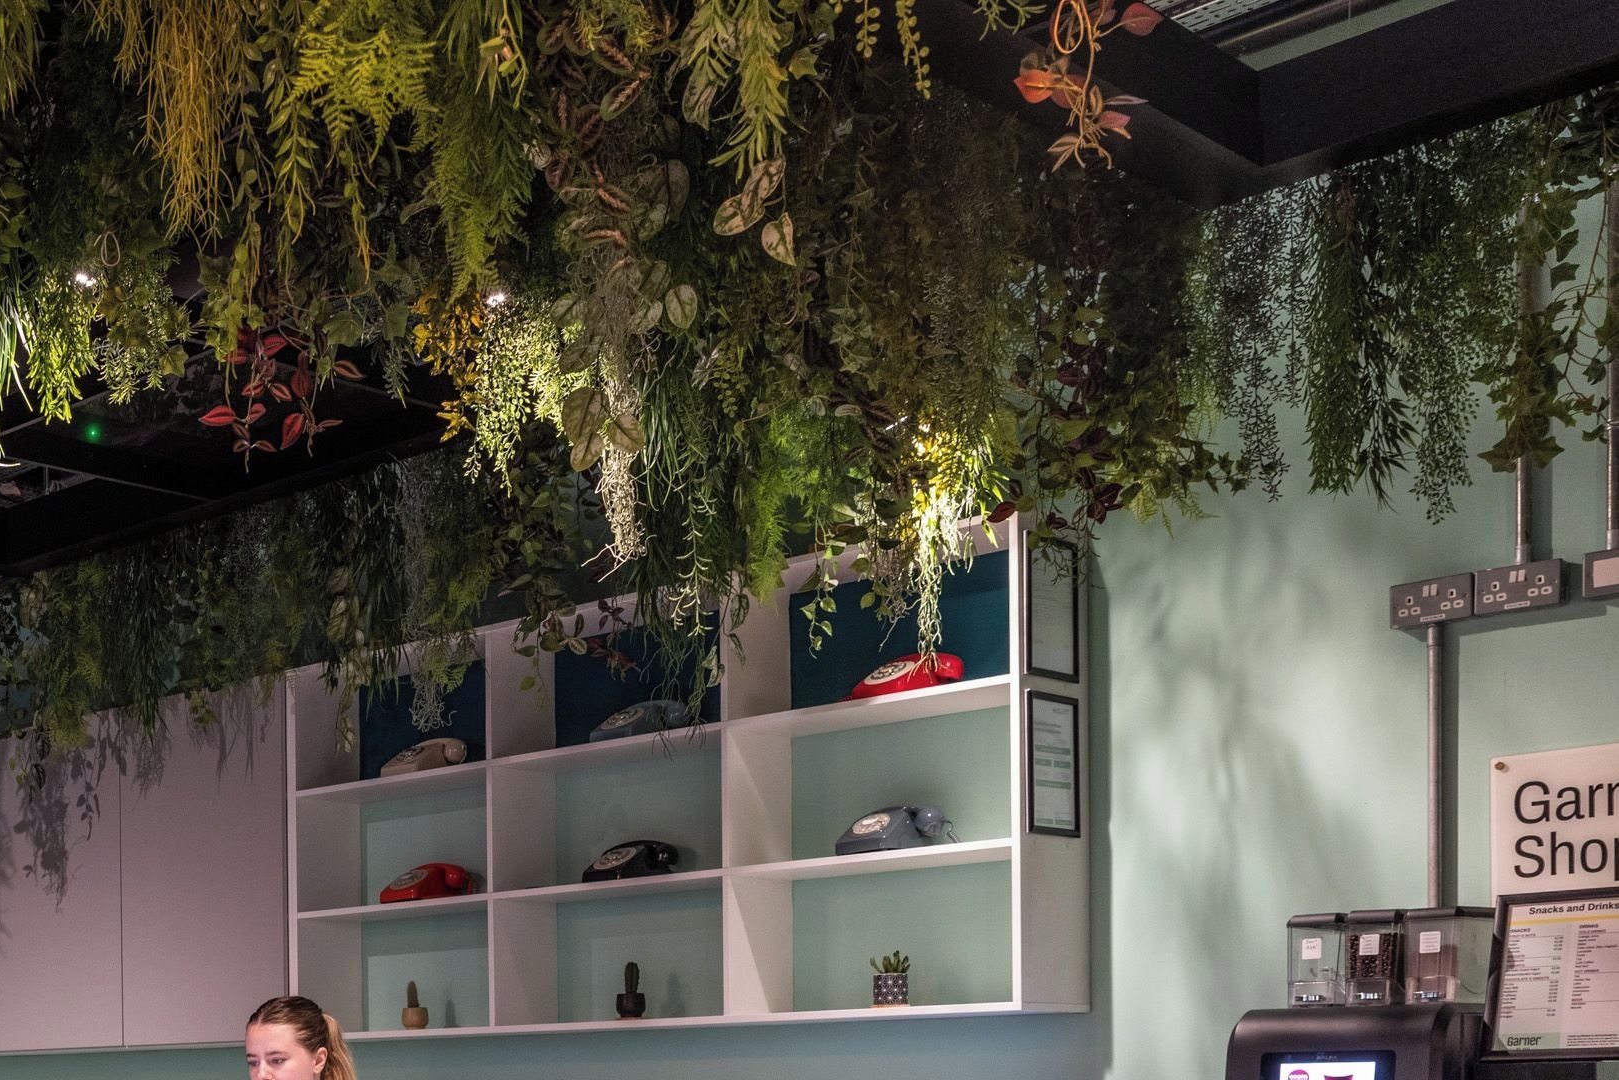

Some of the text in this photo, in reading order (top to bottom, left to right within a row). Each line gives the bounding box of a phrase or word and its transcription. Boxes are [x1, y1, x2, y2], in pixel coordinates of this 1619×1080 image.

[1514, 832, 1619, 881] Sho
[1529, 901, 1619, 915] Snacks and Drinks
[1507, 1036, 1541, 1046] Garner
